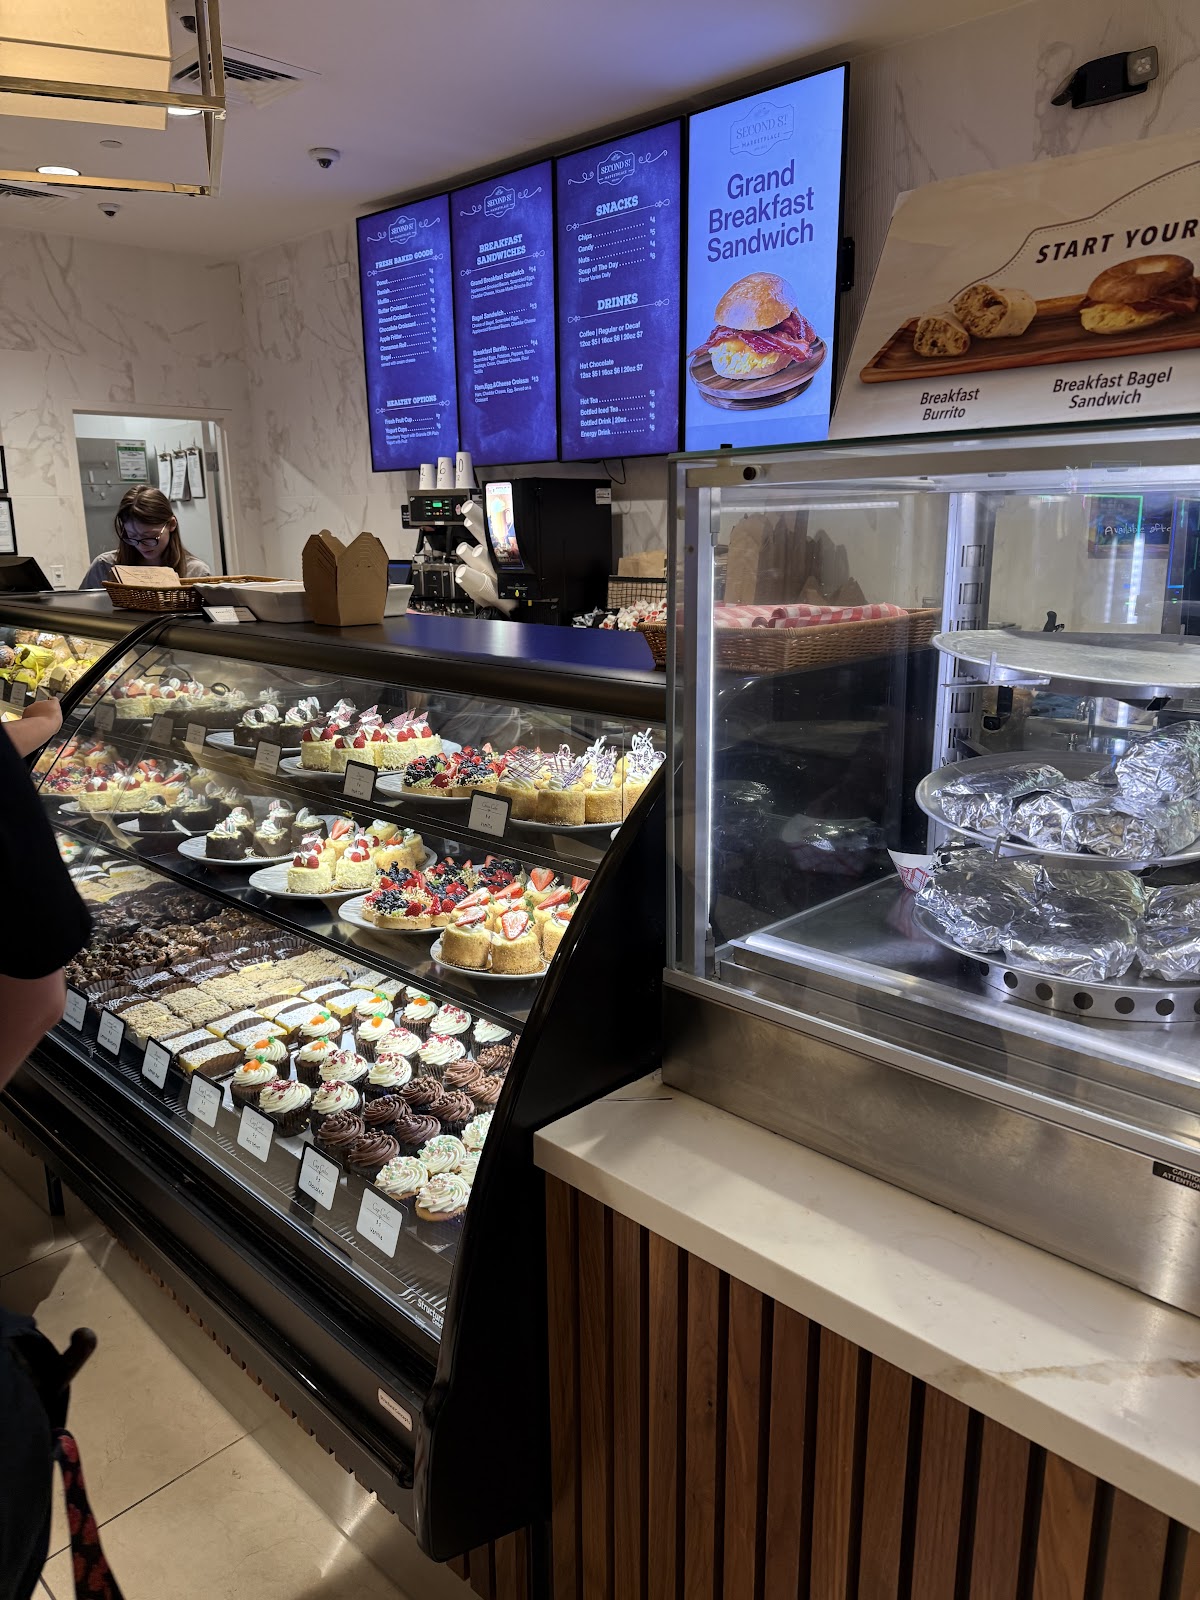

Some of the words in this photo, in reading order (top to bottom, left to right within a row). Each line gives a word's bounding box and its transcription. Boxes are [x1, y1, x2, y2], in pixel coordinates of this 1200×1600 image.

[736, 118, 775, 140] SECOND
[741, 133, 780, 148] MARKETPLACE
[601, 161, 624, 174] SECOND
[727, 158, 795, 200] Grand
[595, 195, 638, 216] SNACKS
[709, 186, 814, 234] Breakfast
[479, 234, 522, 253] BREAKFAST
[578, 233, 592, 242] Chips
[707, 217, 814, 262] Sandwich
[1035, 233, 1115, 264] START
[1126, 219, 1199, 249] YOUR
[476, 245, 526, 265] SANDWICHES
[578, 244, 594, 253] Candy
[375, 259, 393, 269] FRESH
[394, 254, 413, 265] BAKED
[414, 249, 433, 259] GOODS
[578, 256, 590, 265] Nuts
[578, 268, 591, 276] Soup
[598, 263, 607, 271] The
[608, 261, 619, 270] Day
[376, 279, 388, 287] Donut
[470, 278, 483, 287] Grand
[484, 274, 503, 284] Breakfast
[504, 268, 525, 279] Sandwich
[377, 289, 390, 297] Danish
[378, 307, 389, 315] Butter
[390, 304, 408, 313] Croissant
[597, 293, 639, 311] DRINKS
[378, 316, 392, 324] Almond
[392, 313, 411, 322] Croissant
[472, 314, 483, 322] Bagel
[484, 310, 504, 319] Sandwich
[379, 325, 398, 333] Chocolate
[398, 322, 416, 330] Croissant
[579, 331, 595, 339] Coffee
[598, 325, 619, 335] Regular
[625, 321, 641, 330] Decaf
[380, 335, 390, 343] Apple
[390, 333, 402, 341] Fritter
[580, 340, 591, 348] 12oz
[592, 338, 598, 346] $5
[601, 336, 613, 344] 16oz
[624, 332, 636, 340] 20oz
[636, 330, 644, 338] $7
[380, 343, 397, 352] Cinnamon
[473, 347, 492, 356] Breakfast
[493, 345, 507, 353] Burrito
[380, 354, 391, 362] Bagel
[579, 362, 589, 370] Hot
[589, 359, 614, 368] Chocolate
[592, 370, 598, 378] $5
[624, 365, 636, 373] 20oz
[636, 363, 644, 371] $7
[1053, 373, 1124, 393] Breakfast
[1126, 366, 1173, 390] Bagel
[387, 397, 412, 407] HEALTHY
[412, 395, 437, 404] OPTIONS
[920, 387, 980, 405] Breakfast
[1069, 389, 1141, 409] Sandwich
[580, 408, 598, 416] Bottled
[922, 405, 966, 421] Burrito
[580, 419, 598, 427] Bottled
[581, 429, 597, 438] Energy
[598, 428, 611, 436] Drink
[1172, 1168, 1200, 1183] CAUTIO
